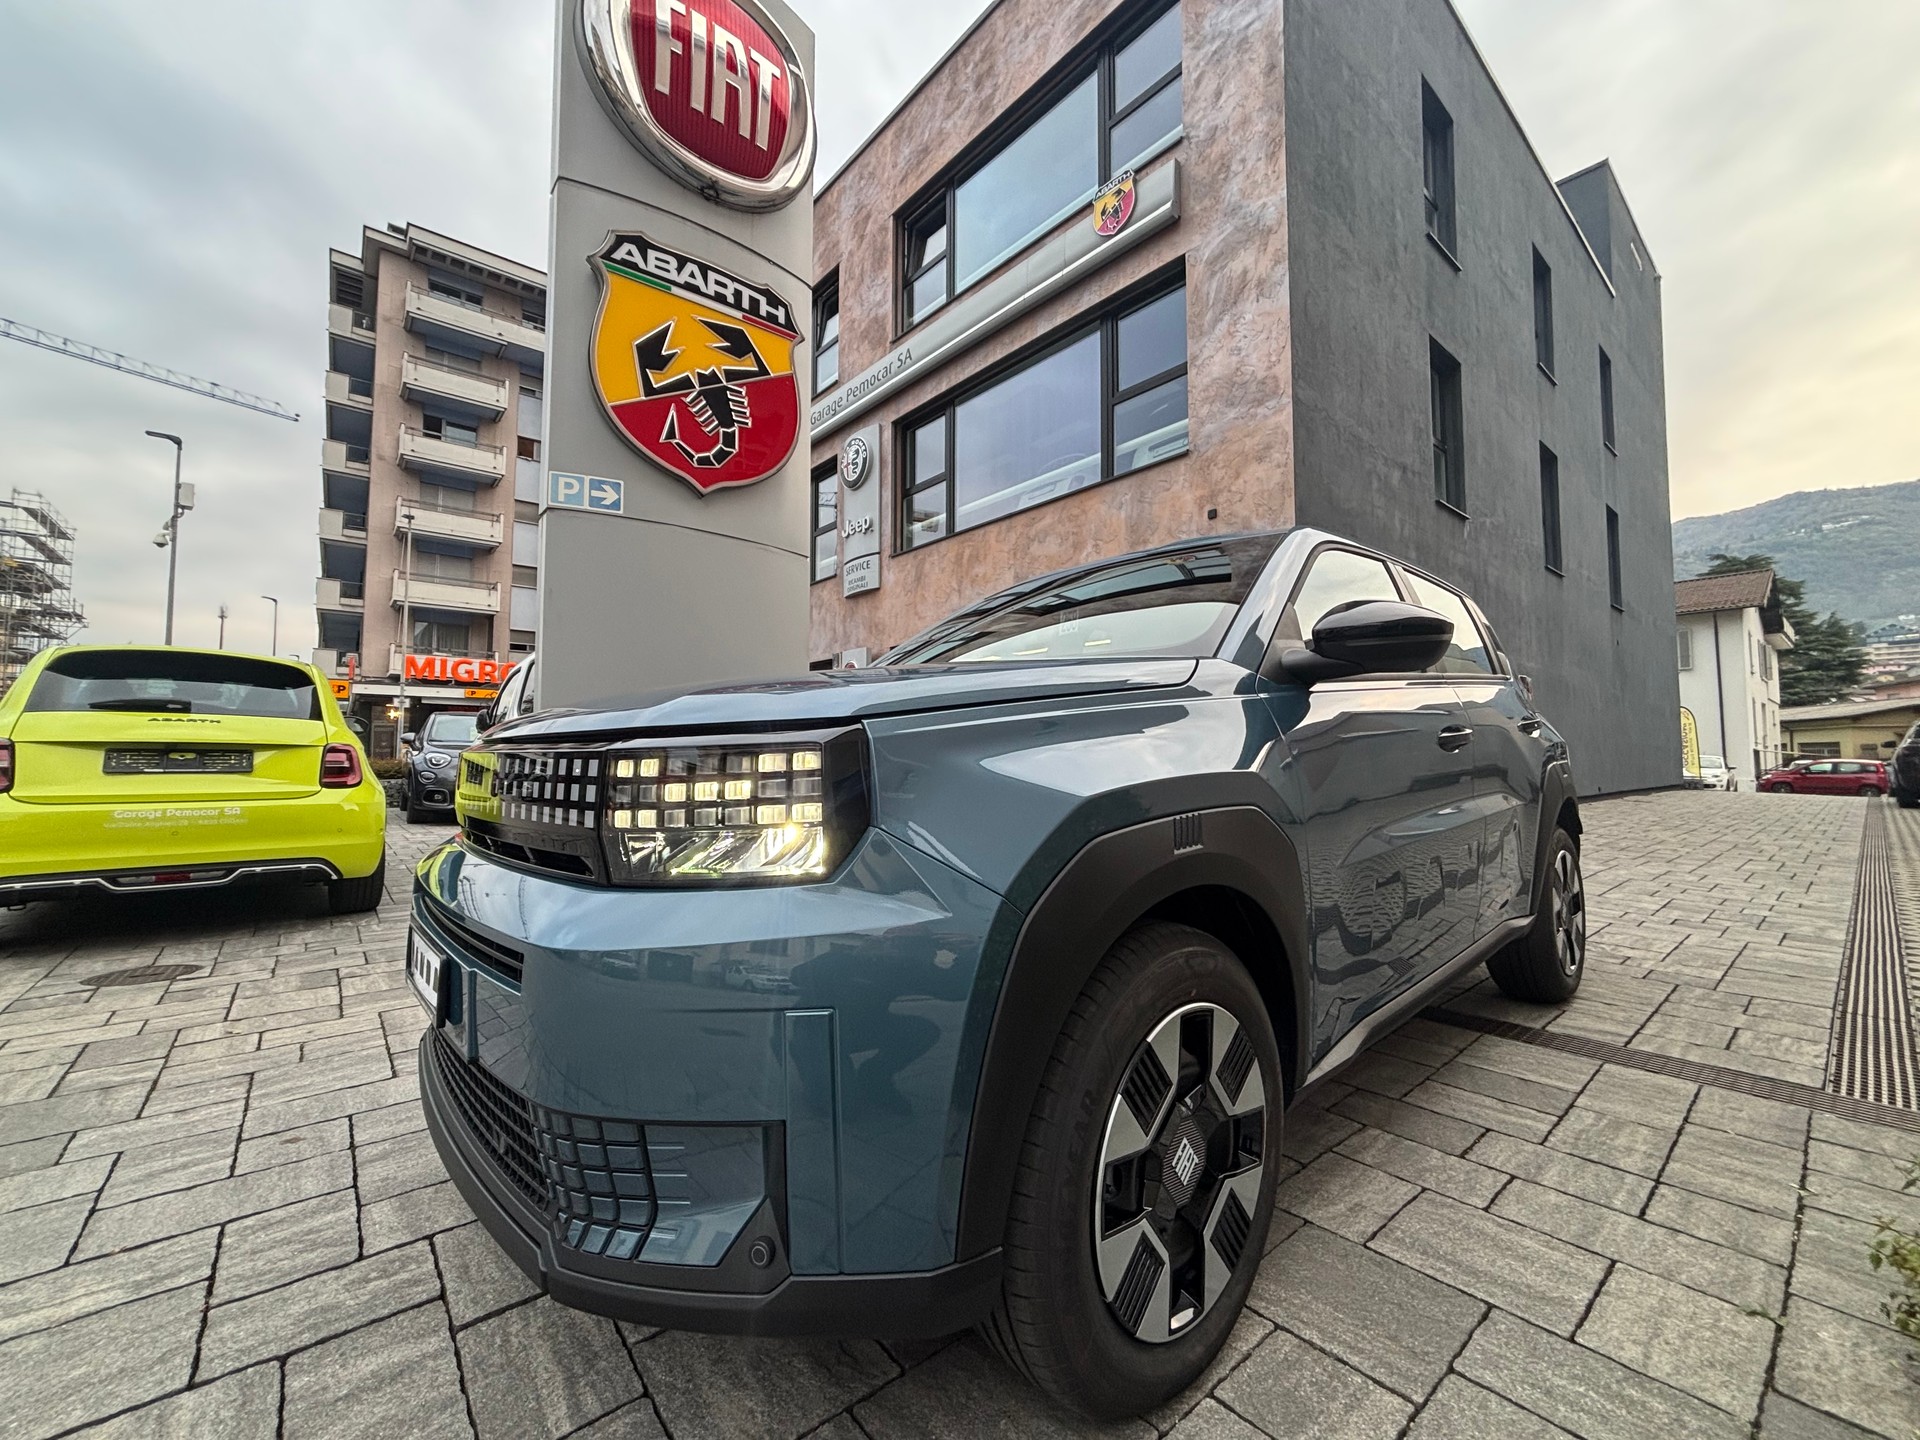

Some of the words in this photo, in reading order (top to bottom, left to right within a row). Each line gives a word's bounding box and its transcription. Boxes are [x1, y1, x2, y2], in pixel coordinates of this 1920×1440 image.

[654, 0, 781, 152] FIAT
[1095, 171, 1131, 199] ABARTH
[610, 241, 786, 325] ABARTH
[810, 396, 843, 426] Garage
[846, 360, 894, 403] Pemocar
[896, 347, 913, 370] SA
[557, 475, 580, 502] P
[841, 514, 871, 538] Jeep
[845, 559, 871, 577] SERVICE
[114, 810, 163, 820] Garage
[166, 808, 221, 818] Pemocar
[223, 807, 241, 816] SA
[1172, 1136, 1199, 1187] FIAT
